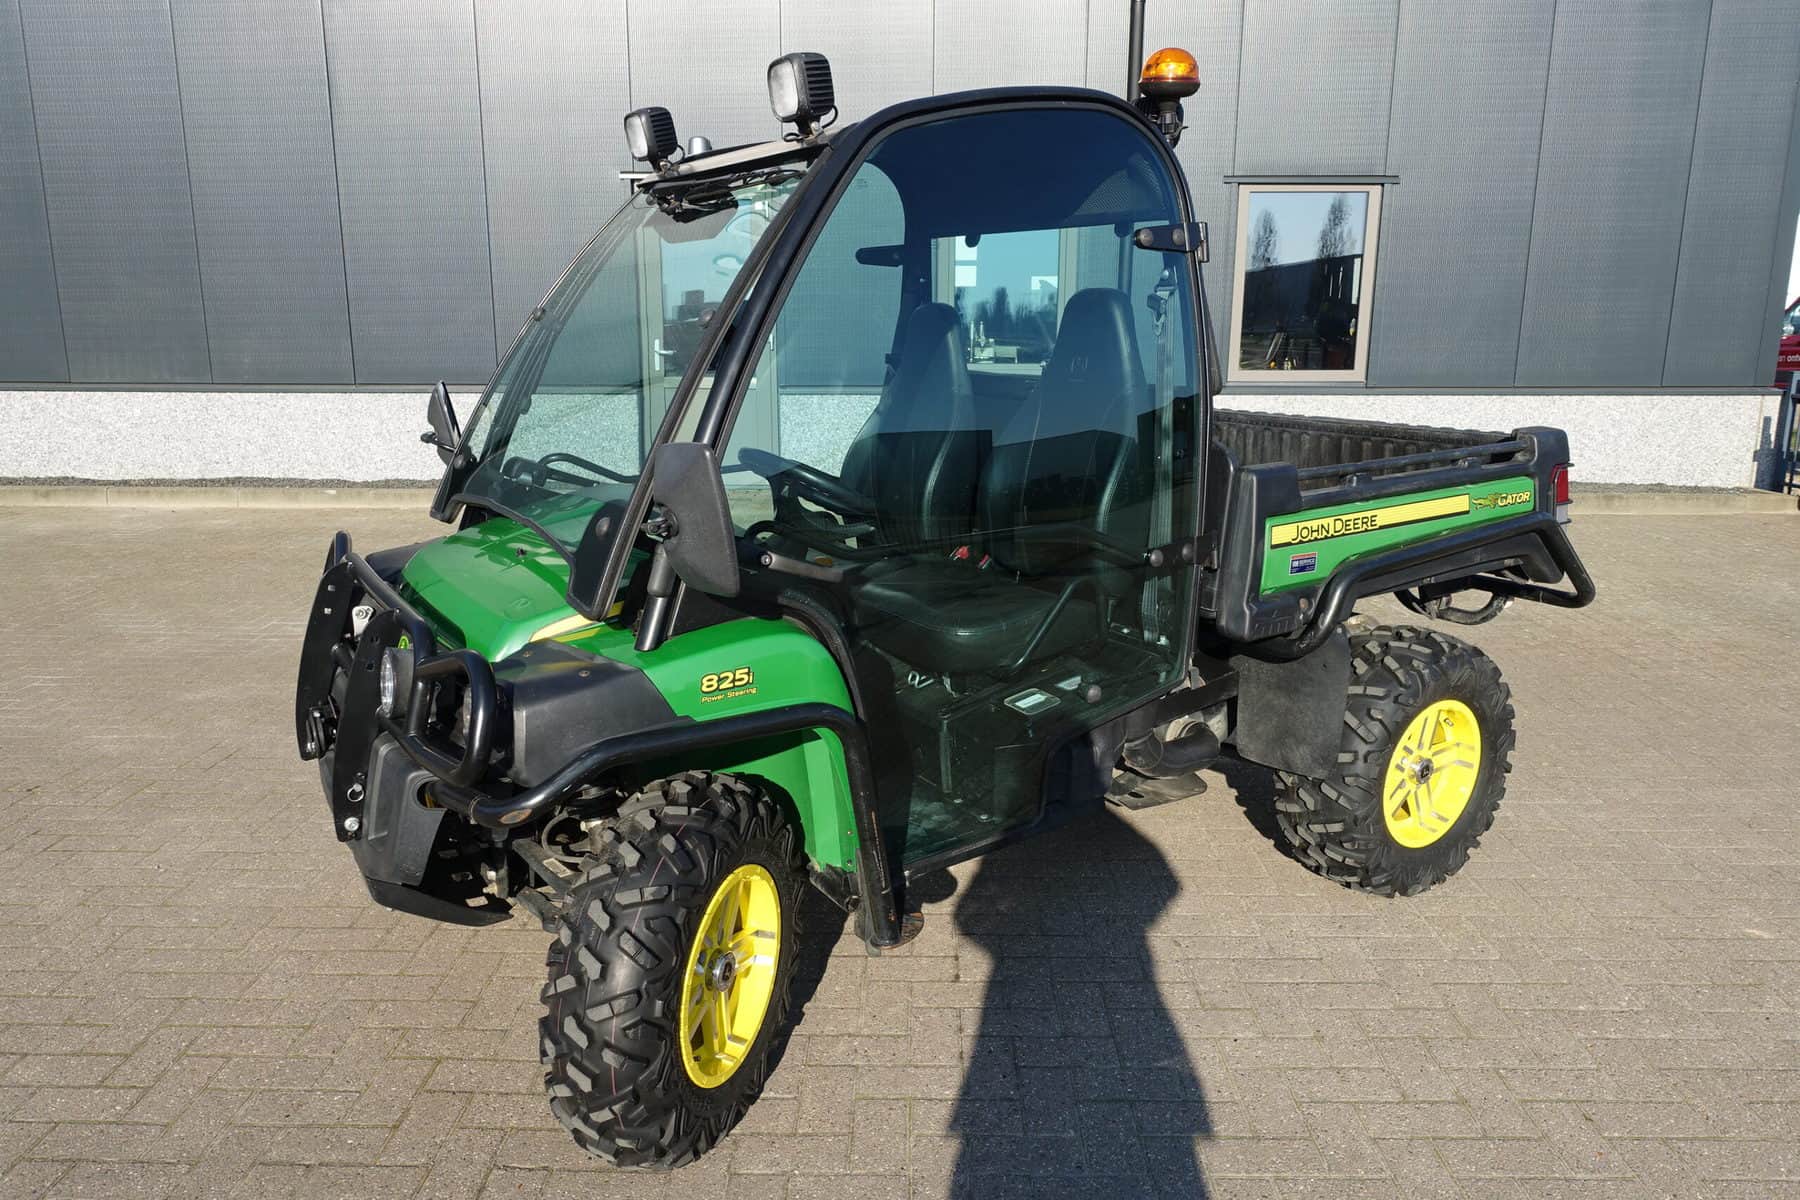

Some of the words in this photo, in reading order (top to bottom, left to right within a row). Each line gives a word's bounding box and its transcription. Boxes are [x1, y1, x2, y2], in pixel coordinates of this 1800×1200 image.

[1497, 491, 1531, 507] GATOR
[1291, 517, 1330, 541] JOHN
[1333, 514, 1378, 534] DEERE
[701, 667, 754, 693] 825i
[702, 694, 725, 703] Power
[727, 687, 757, 698] Steering
